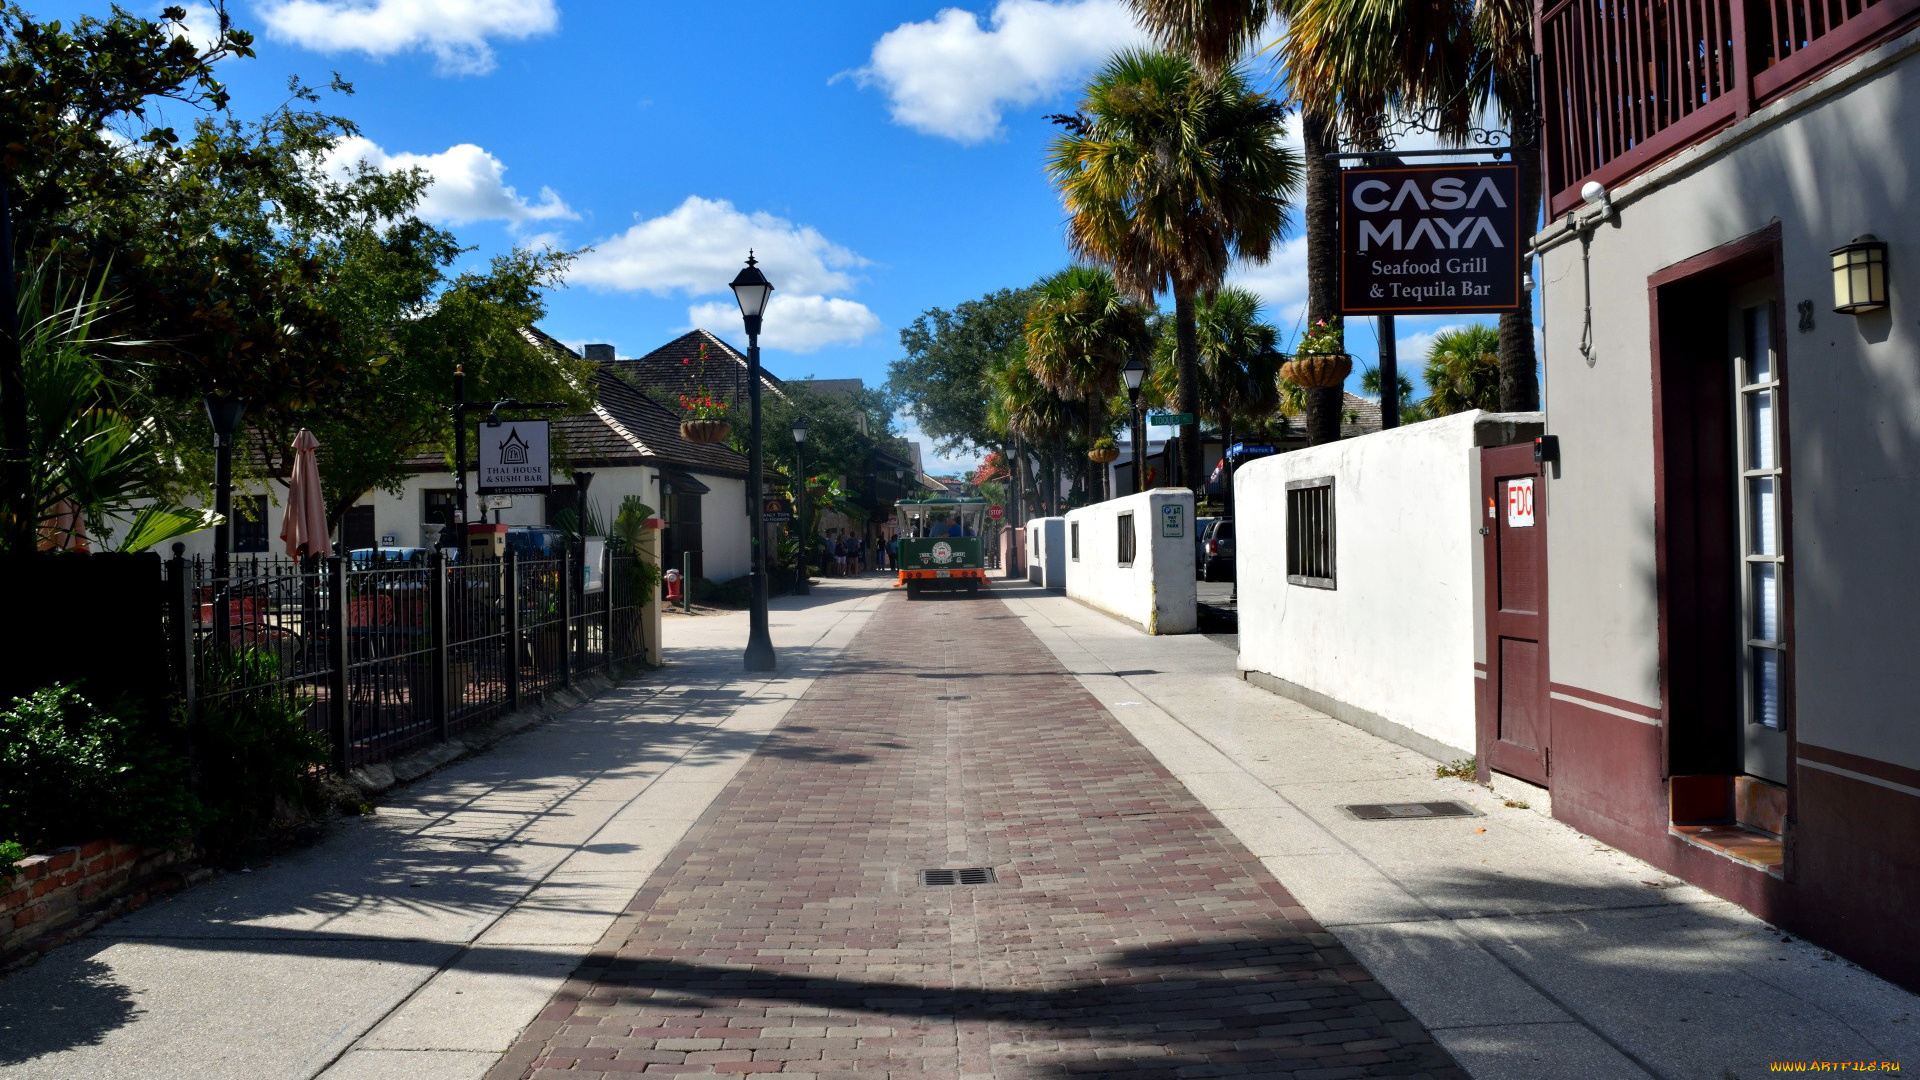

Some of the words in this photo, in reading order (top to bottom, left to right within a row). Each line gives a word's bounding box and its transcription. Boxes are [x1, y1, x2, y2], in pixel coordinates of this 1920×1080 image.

[1352, 176, 1507, 213] CASA
[1359, 216, 1505, 251] MAYA
[1371, 258, 1441, 276] Seafood
[1446, 257, 1488, 273] Grill
[1369, 283, 1385, 298] &
[1389, 281, 1456, 302] Tequila
[1461, 281, 1491, 297] Bar
[513, 466, 542, 474] HOUSE
[524, 474, 542, 482] BAR
[1509, 486, 1532, 516] FDC
